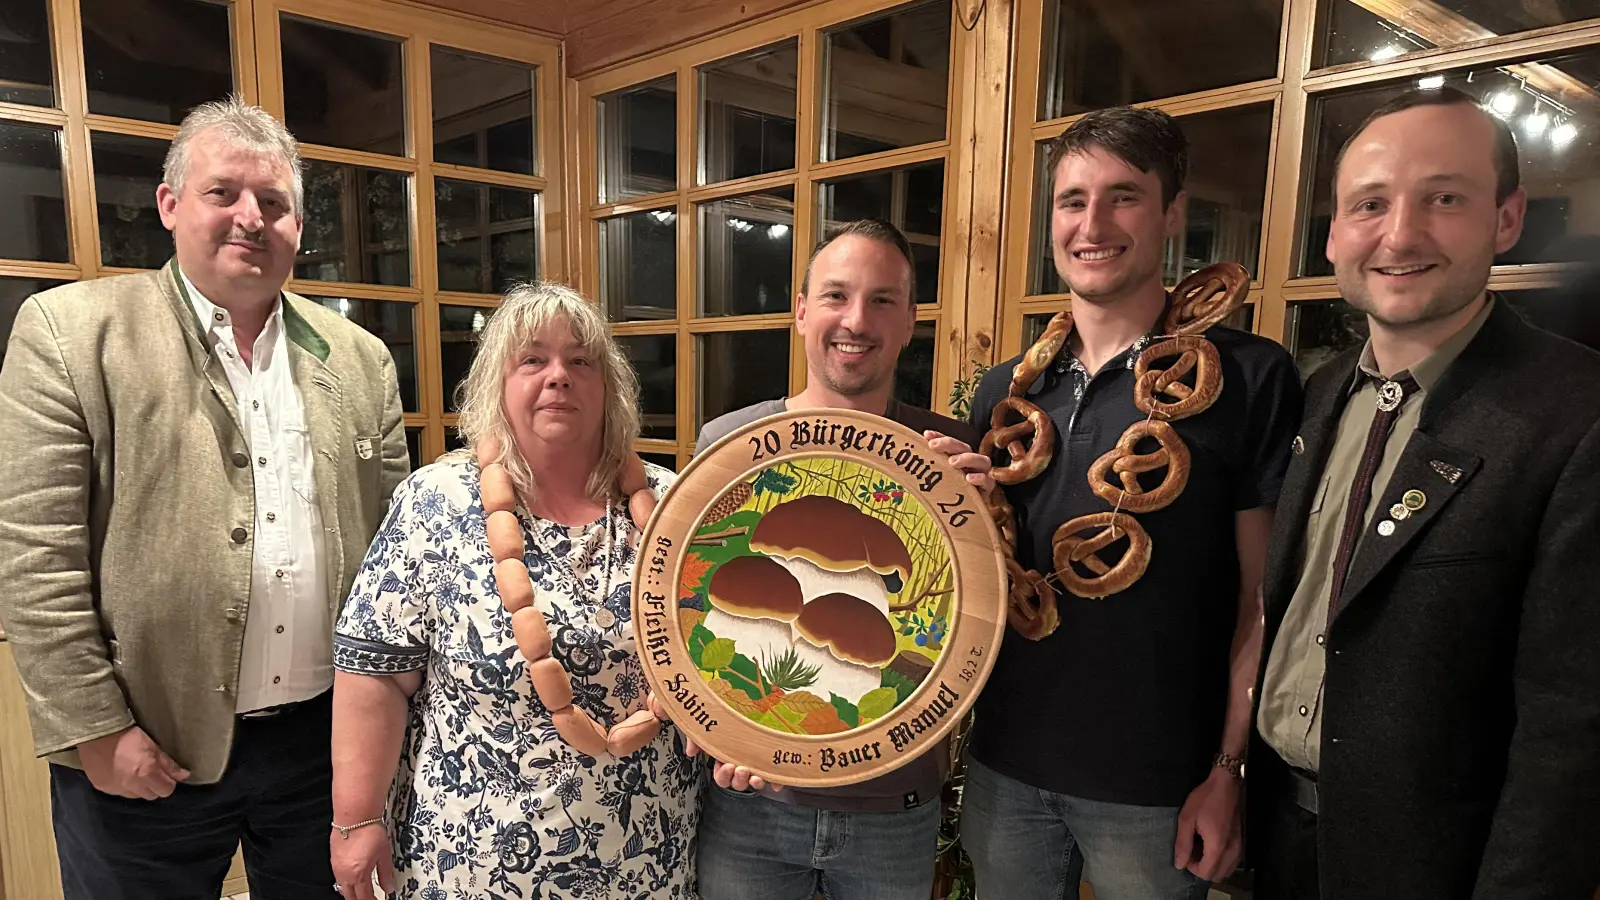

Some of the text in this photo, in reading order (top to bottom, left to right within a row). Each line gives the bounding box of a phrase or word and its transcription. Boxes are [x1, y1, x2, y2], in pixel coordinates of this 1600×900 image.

[749, 419, 976, 528] 20 Bürgerkönig 26
[663, 672, 719, 733] Sabine
[818, 740, 882, 772] Bauer
[886, 680, 959, 752] Manuel
